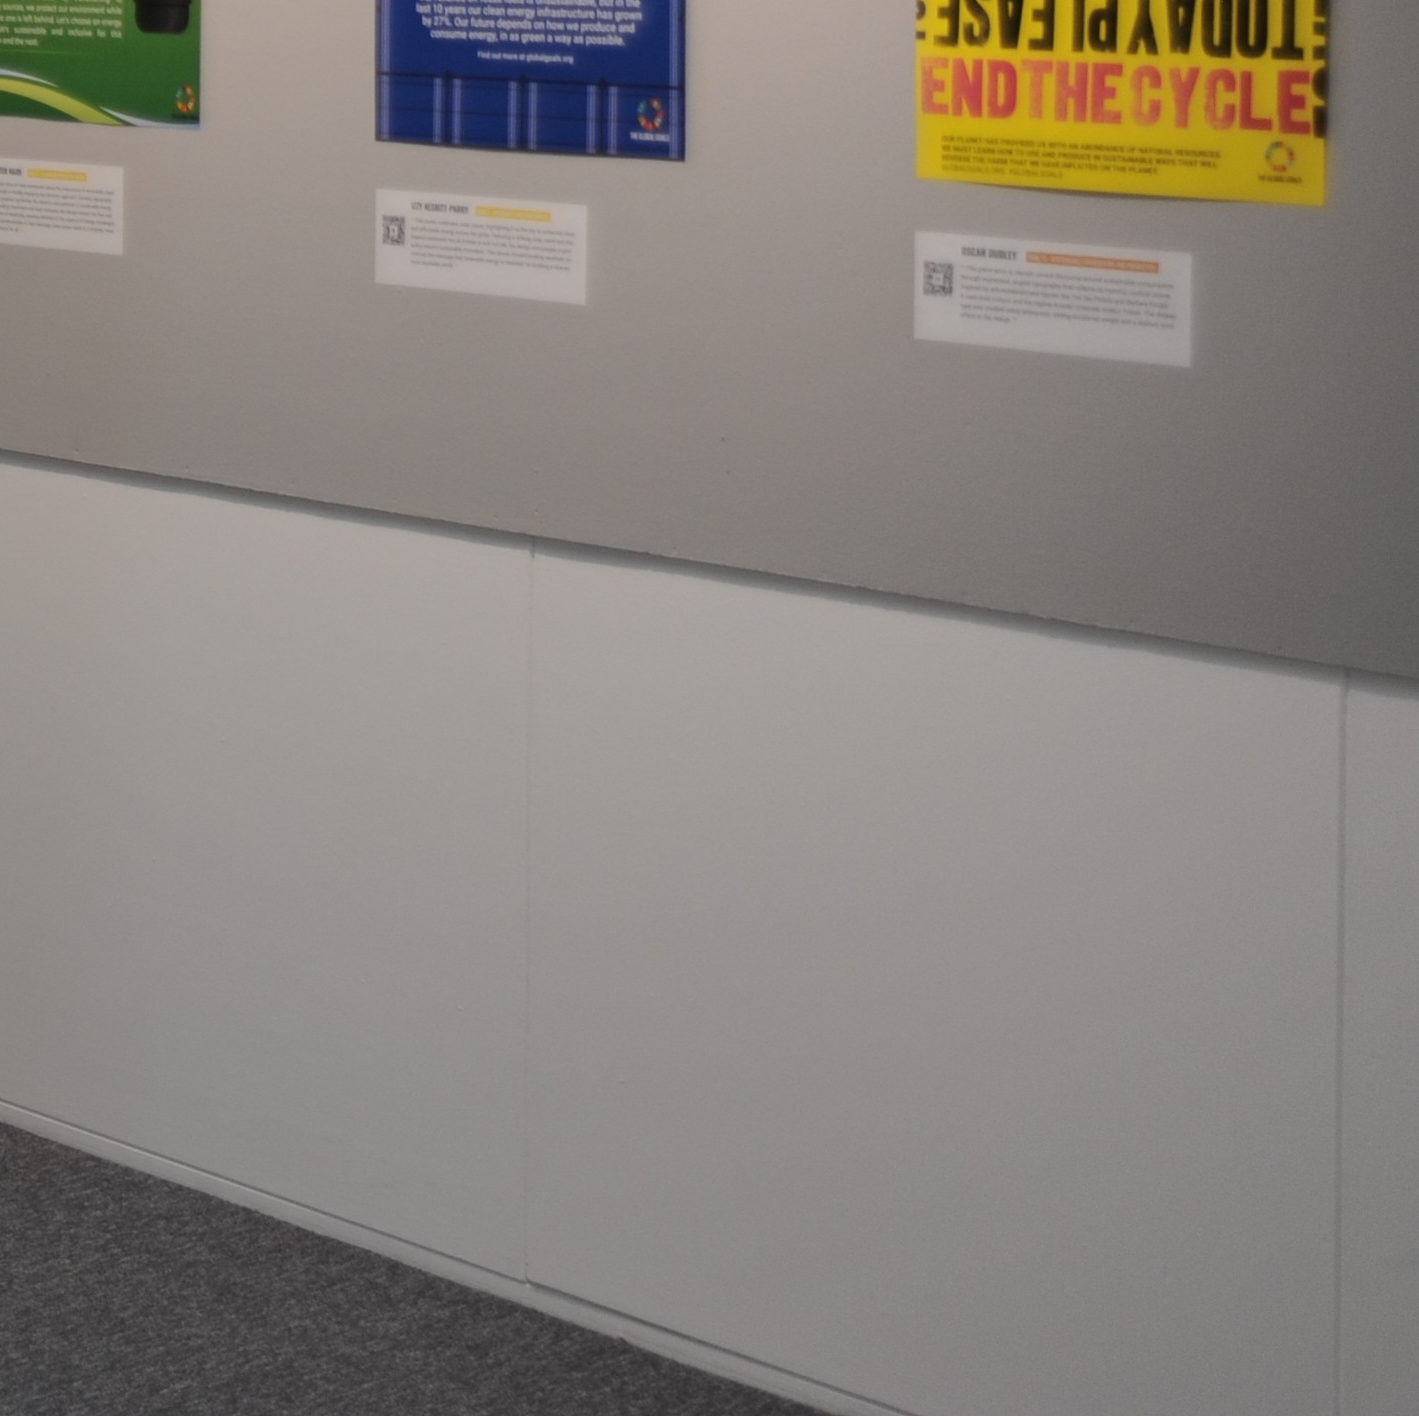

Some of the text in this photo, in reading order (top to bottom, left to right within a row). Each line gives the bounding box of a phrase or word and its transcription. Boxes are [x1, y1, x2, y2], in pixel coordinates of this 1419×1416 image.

[416, 2, 642, 22] last 10 years our clean energy infrastructure has grown
[422, 15, 432, 27] by
[454, 16, 468, 27] Our
[470, 16, 495, 28] future
[496, 18, 532, 30] depends
[533, 21, 544, 30] on
[546, 19, 564, 30] how
[566, 22, 579, 31] we
[580, 21, 616, 33] produce
[618, 22, 635, 33] and
[430, 30, 467, 39] consume
[499, 31, 508, 41] in
[509, 32, 519, 41] as
[521, 33, 545, 44] green
[546, 34, 553, 43] a
[554, 35, 572, 46] way
[573, 35, 584, 44] as
[920, 56, 1312, 136] END THE CYCLE
